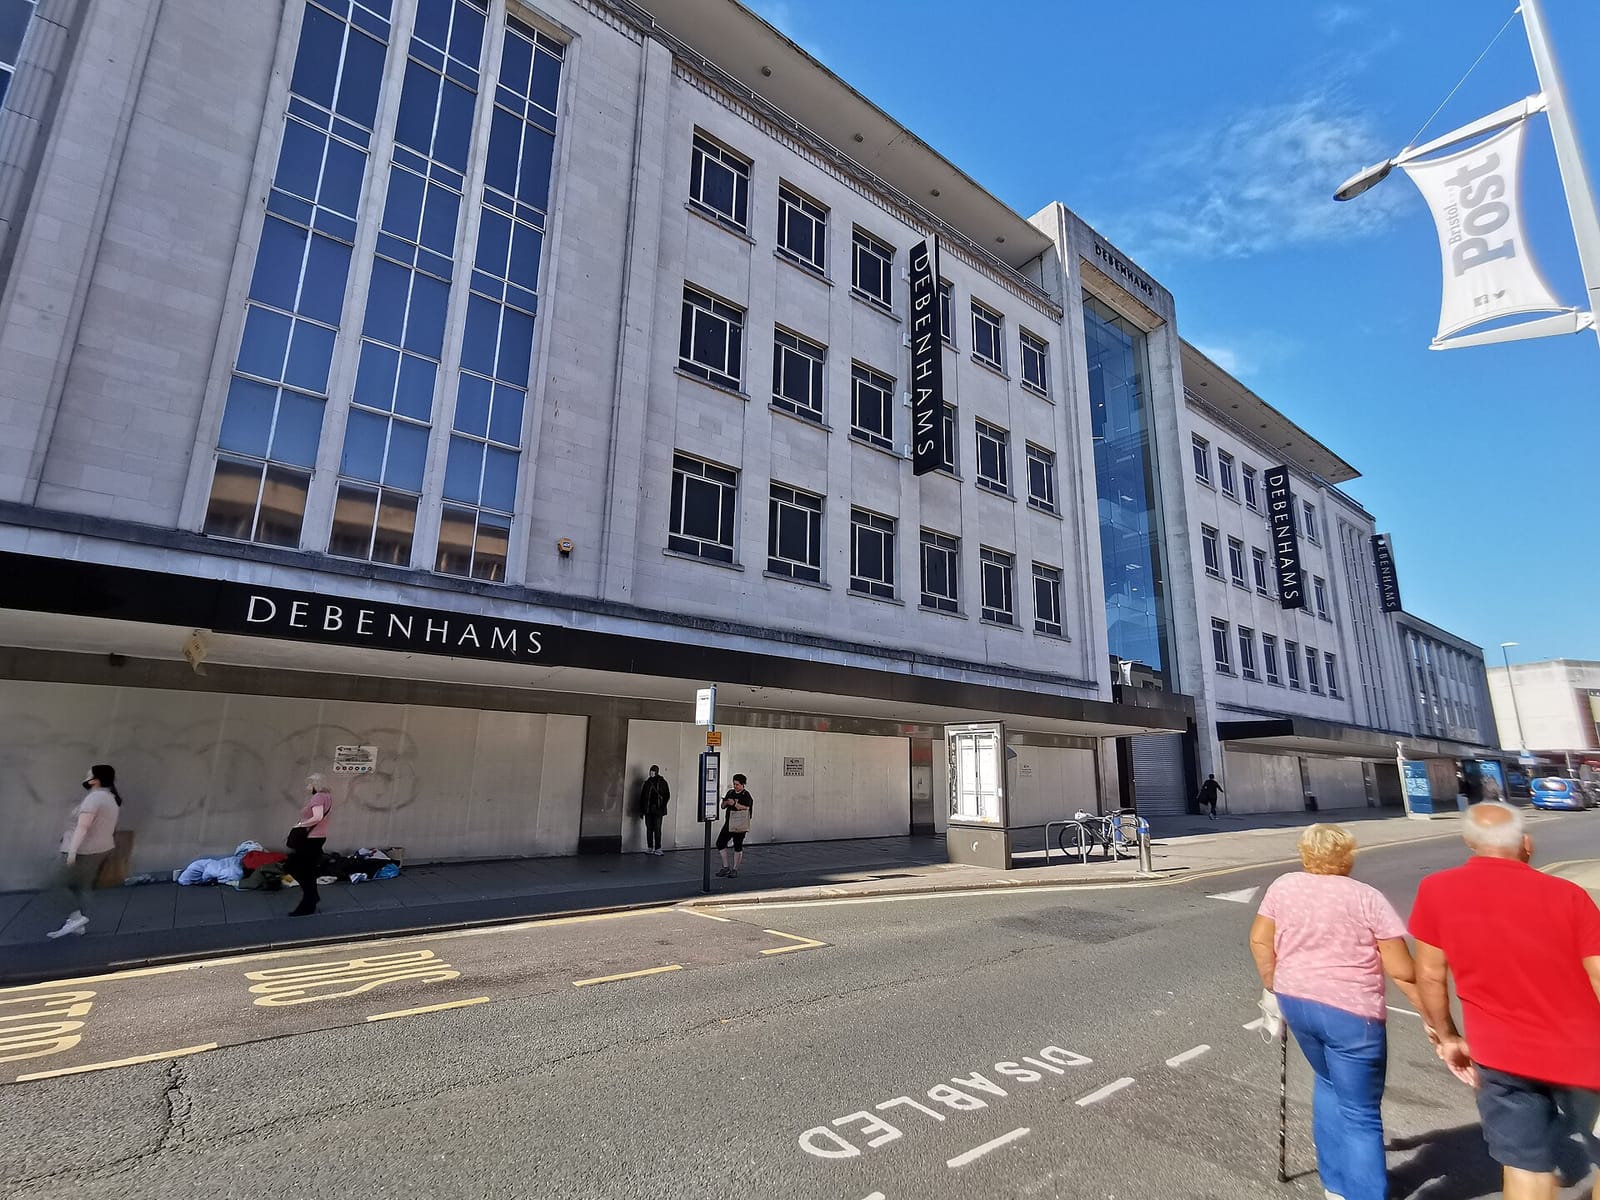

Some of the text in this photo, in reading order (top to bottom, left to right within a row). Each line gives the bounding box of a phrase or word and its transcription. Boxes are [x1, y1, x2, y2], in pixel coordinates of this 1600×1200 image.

[1443, 201, 1461, 246] Bristol
[1444, 152, 1516, 277] Post
[1095, 243, 1152, 296] DEBENHAMS
[913, 251, 934, 456] DEBENHAMS
[1269, 474, 1299, 599] DEBENHAMS
[1378, 540, 1397, 607] DEBENHAMS
[246, 595, 542, 654] DEBENHAMS
[244, 950, 461, 1006] BUS
[798, 1045, 1093, 1159] DISABLED
